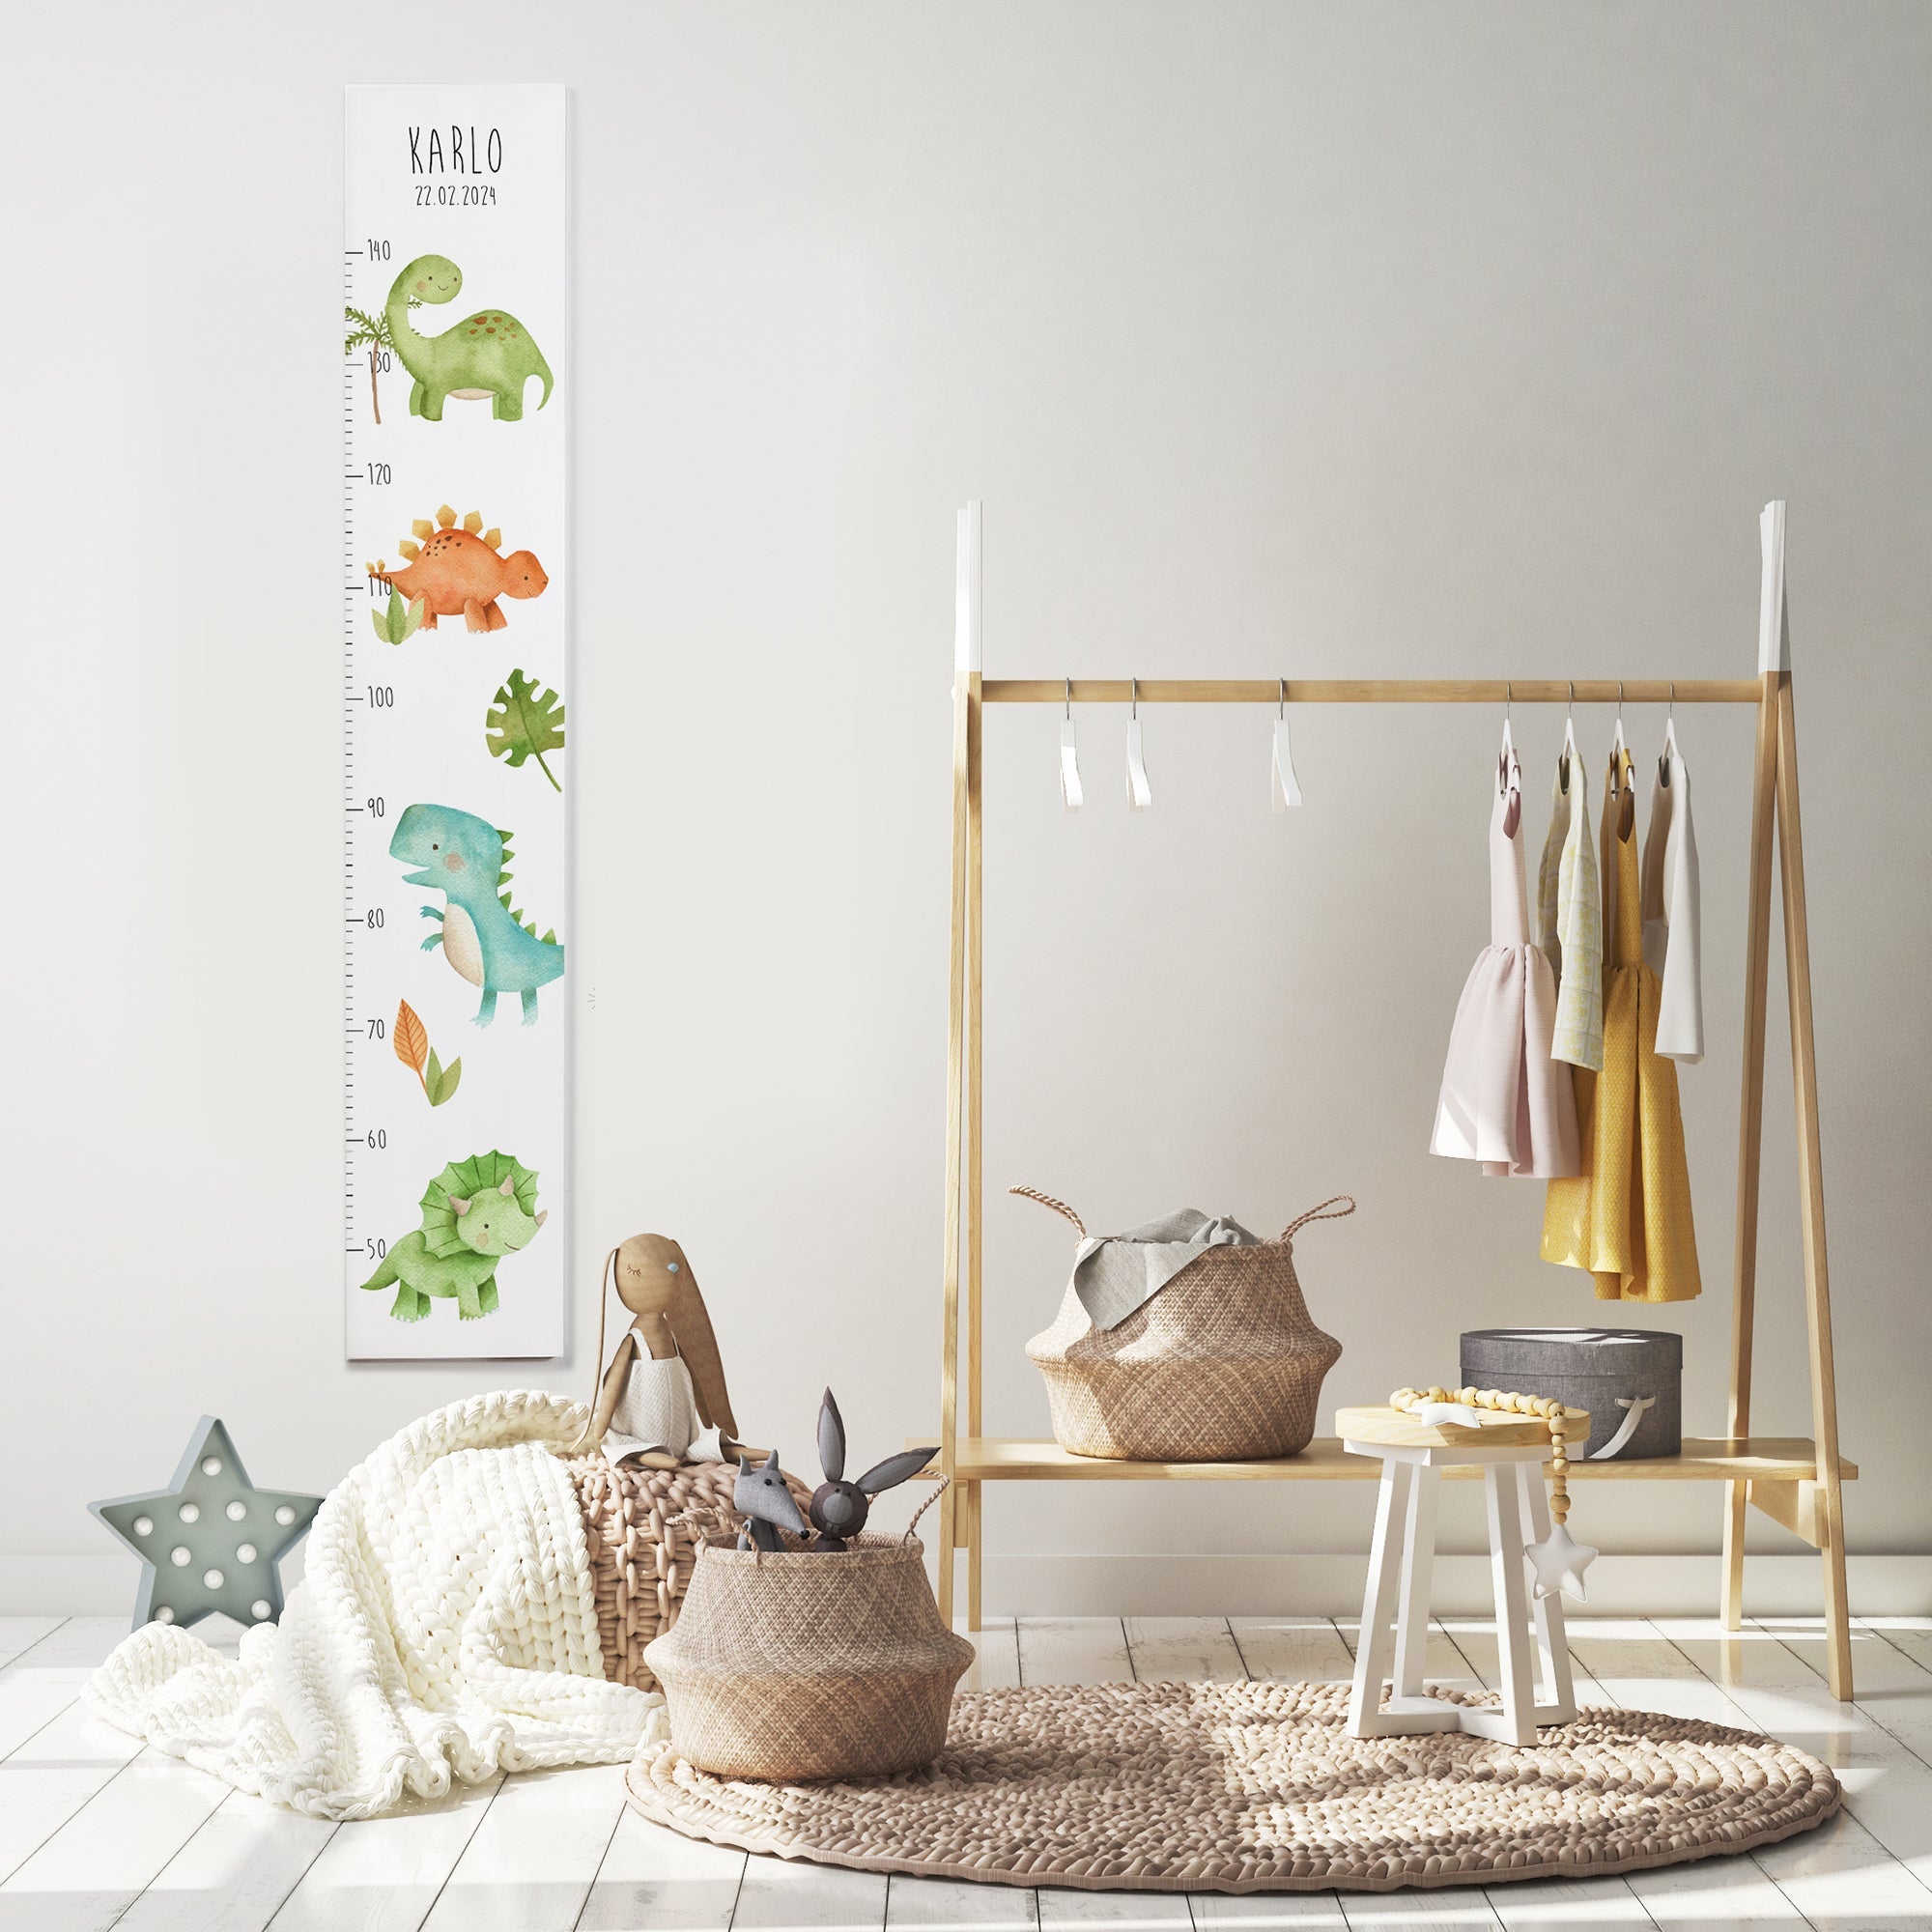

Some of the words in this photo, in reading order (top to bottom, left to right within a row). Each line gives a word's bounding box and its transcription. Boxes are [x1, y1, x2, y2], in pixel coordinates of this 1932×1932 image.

[408, 125, 502, 175] KARLO
[414, 185, 497, 207] 22.02.2024
[367, 239, 391, 262] 140
[367, 351, 391, 375] 130
[367, 462, 391, 486] 120
[367, 574, 393, 597] 110
[367, 685, 394, 709] 100
[367, 796, 384, 818] 90
[367, 907, 384, 929] 80
[367, 1018, 385, 1039] 70
[367, 1128, 386, 1150] 60
[367, 1237, 385, 1260] 50
